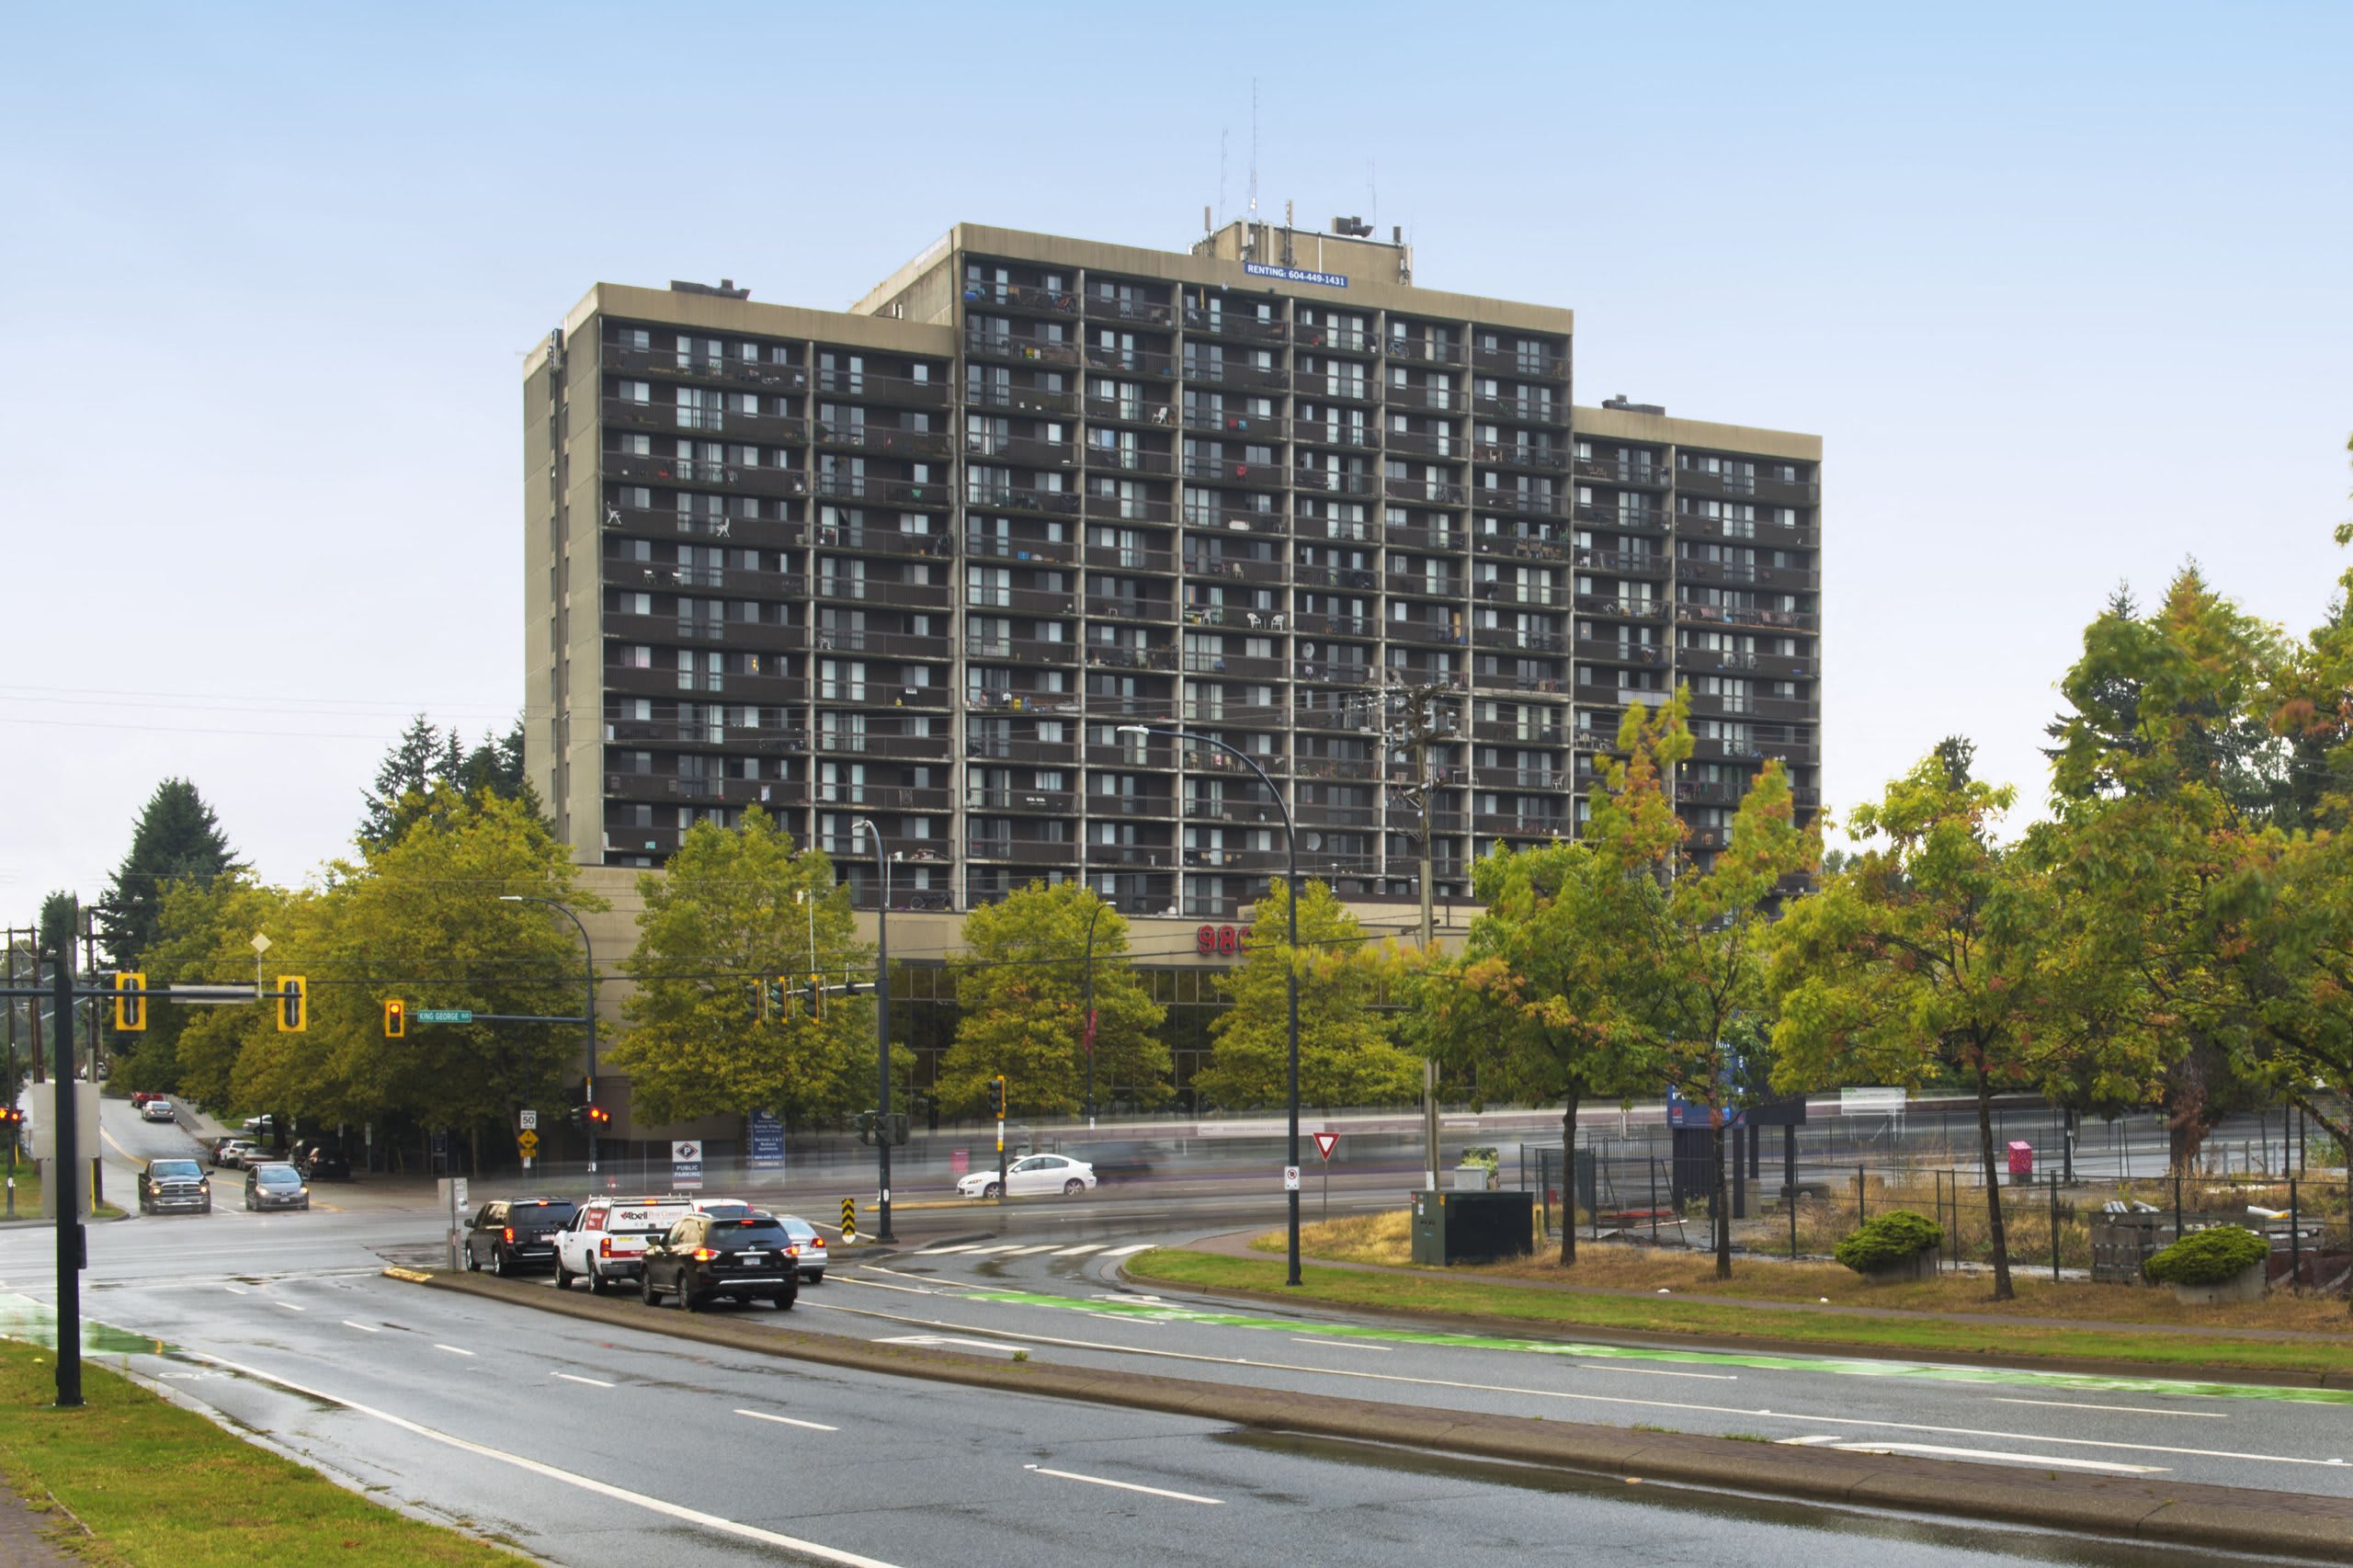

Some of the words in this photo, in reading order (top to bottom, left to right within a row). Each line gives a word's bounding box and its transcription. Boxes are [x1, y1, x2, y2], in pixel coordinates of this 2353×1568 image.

[1247, 264, 1286, 278] RENTING:
[1289, 270, 1345, 286] 604-449-1431
[419, 1012, 434, 1020] KING
[435, 1012, 459, 1021] GEORGE
[522, 1116, 535, 1125] 50
[683, 1147, 691, 1156] P
[624, 1210, 648, 1220] Abell
